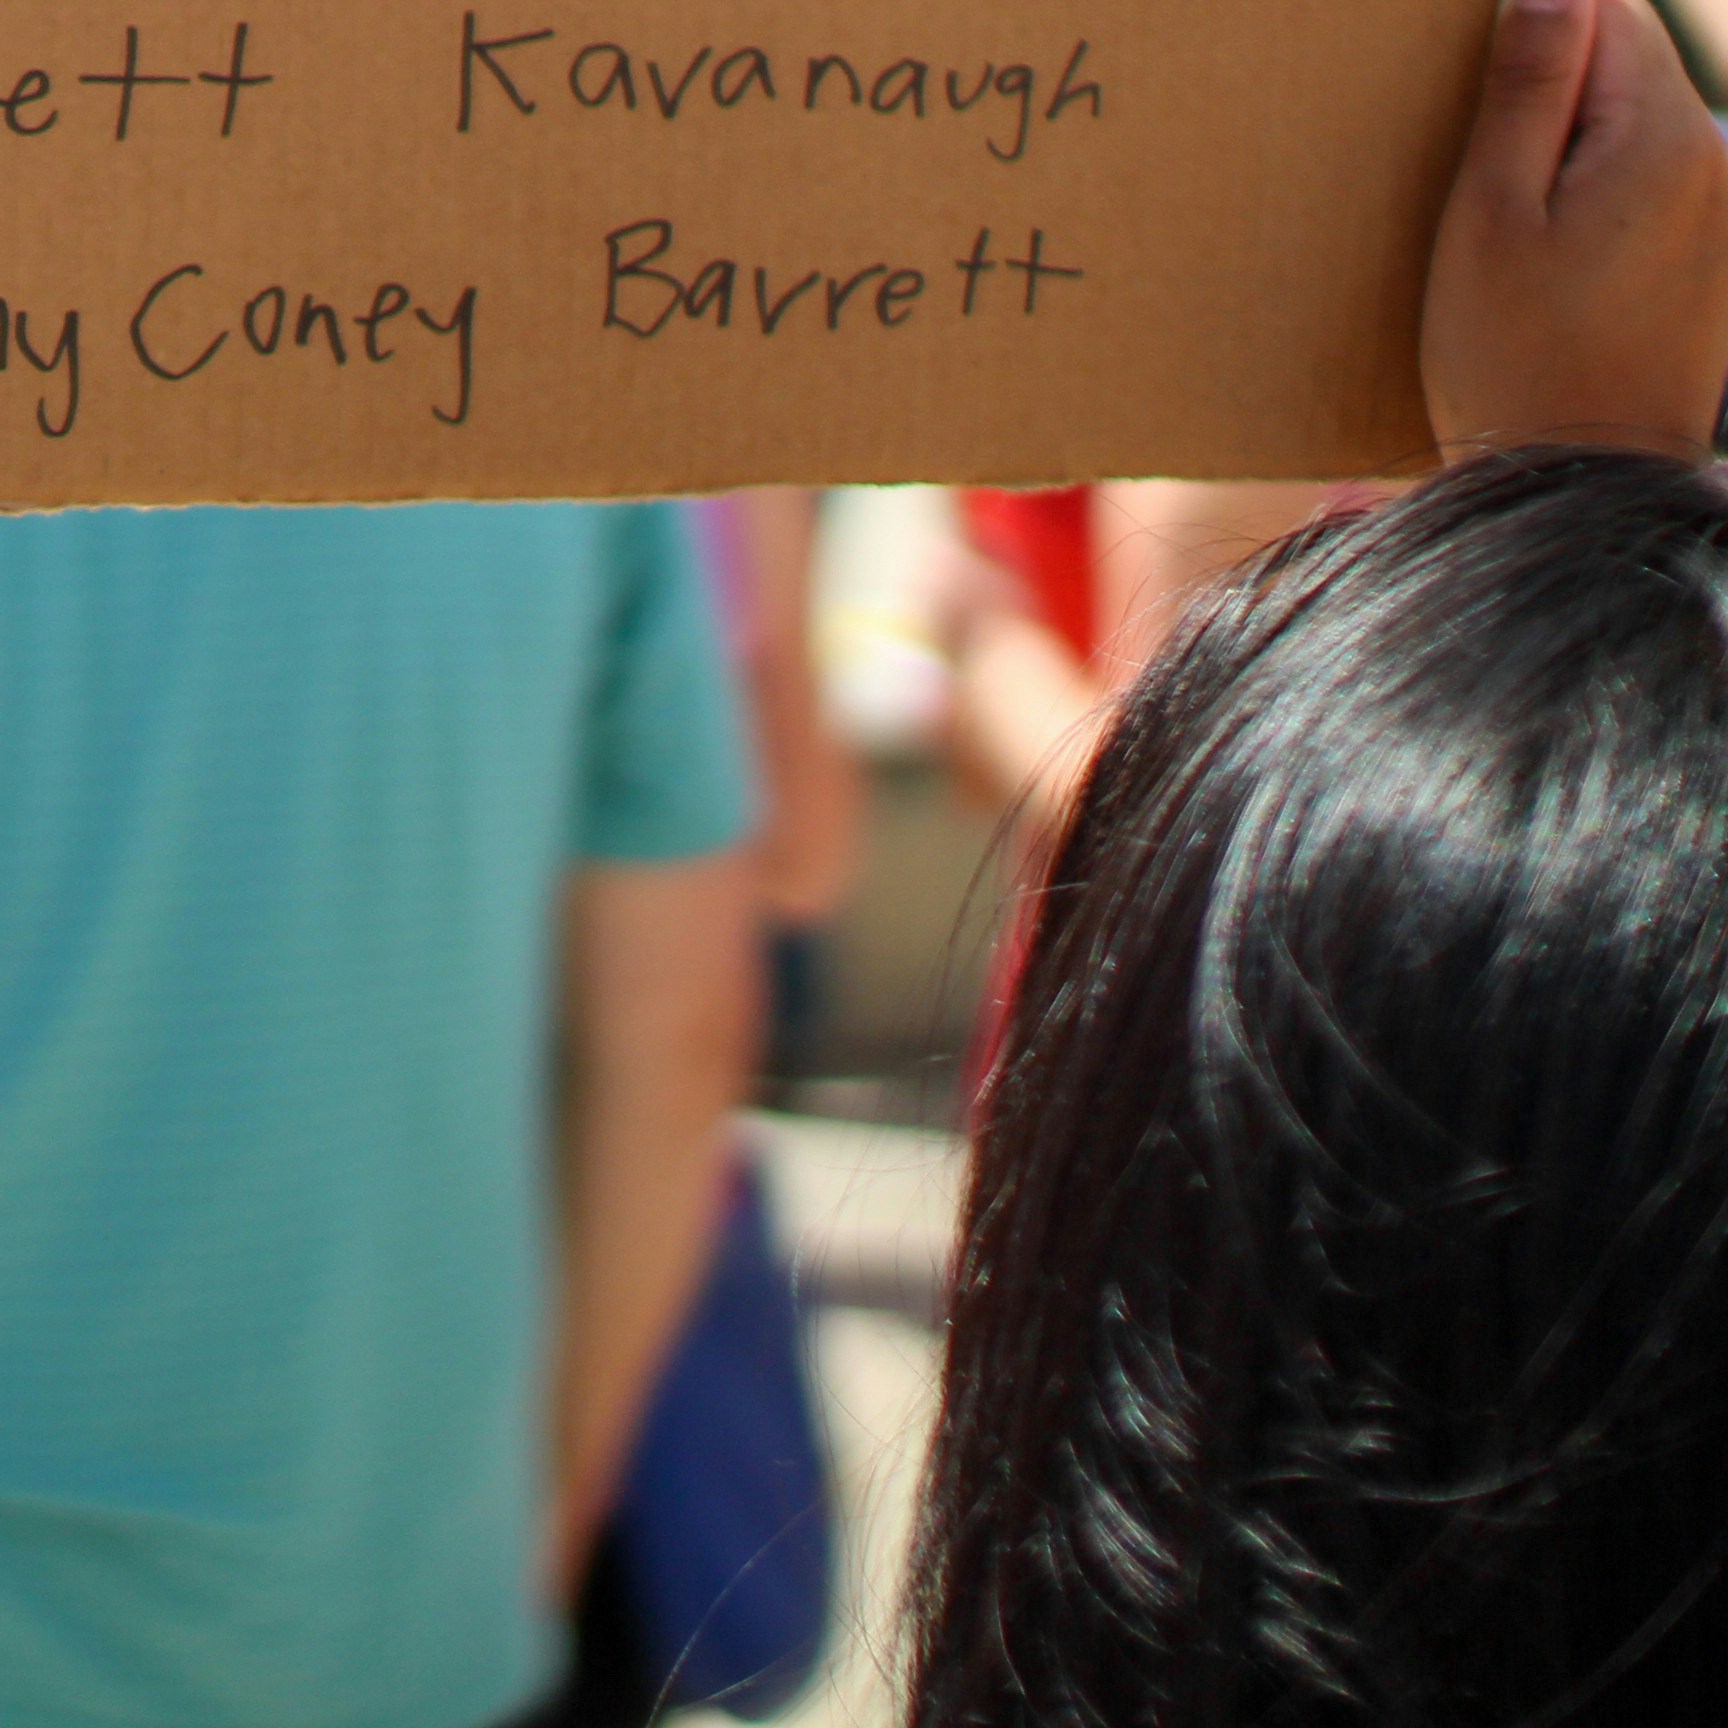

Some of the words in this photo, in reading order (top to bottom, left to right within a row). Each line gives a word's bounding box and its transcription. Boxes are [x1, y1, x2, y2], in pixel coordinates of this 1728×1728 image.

[454, 8, 1102, 164] Kavanaugh
[127, 262, 479, 428] Coney
[601, 217, 1084, 341] Barrett
